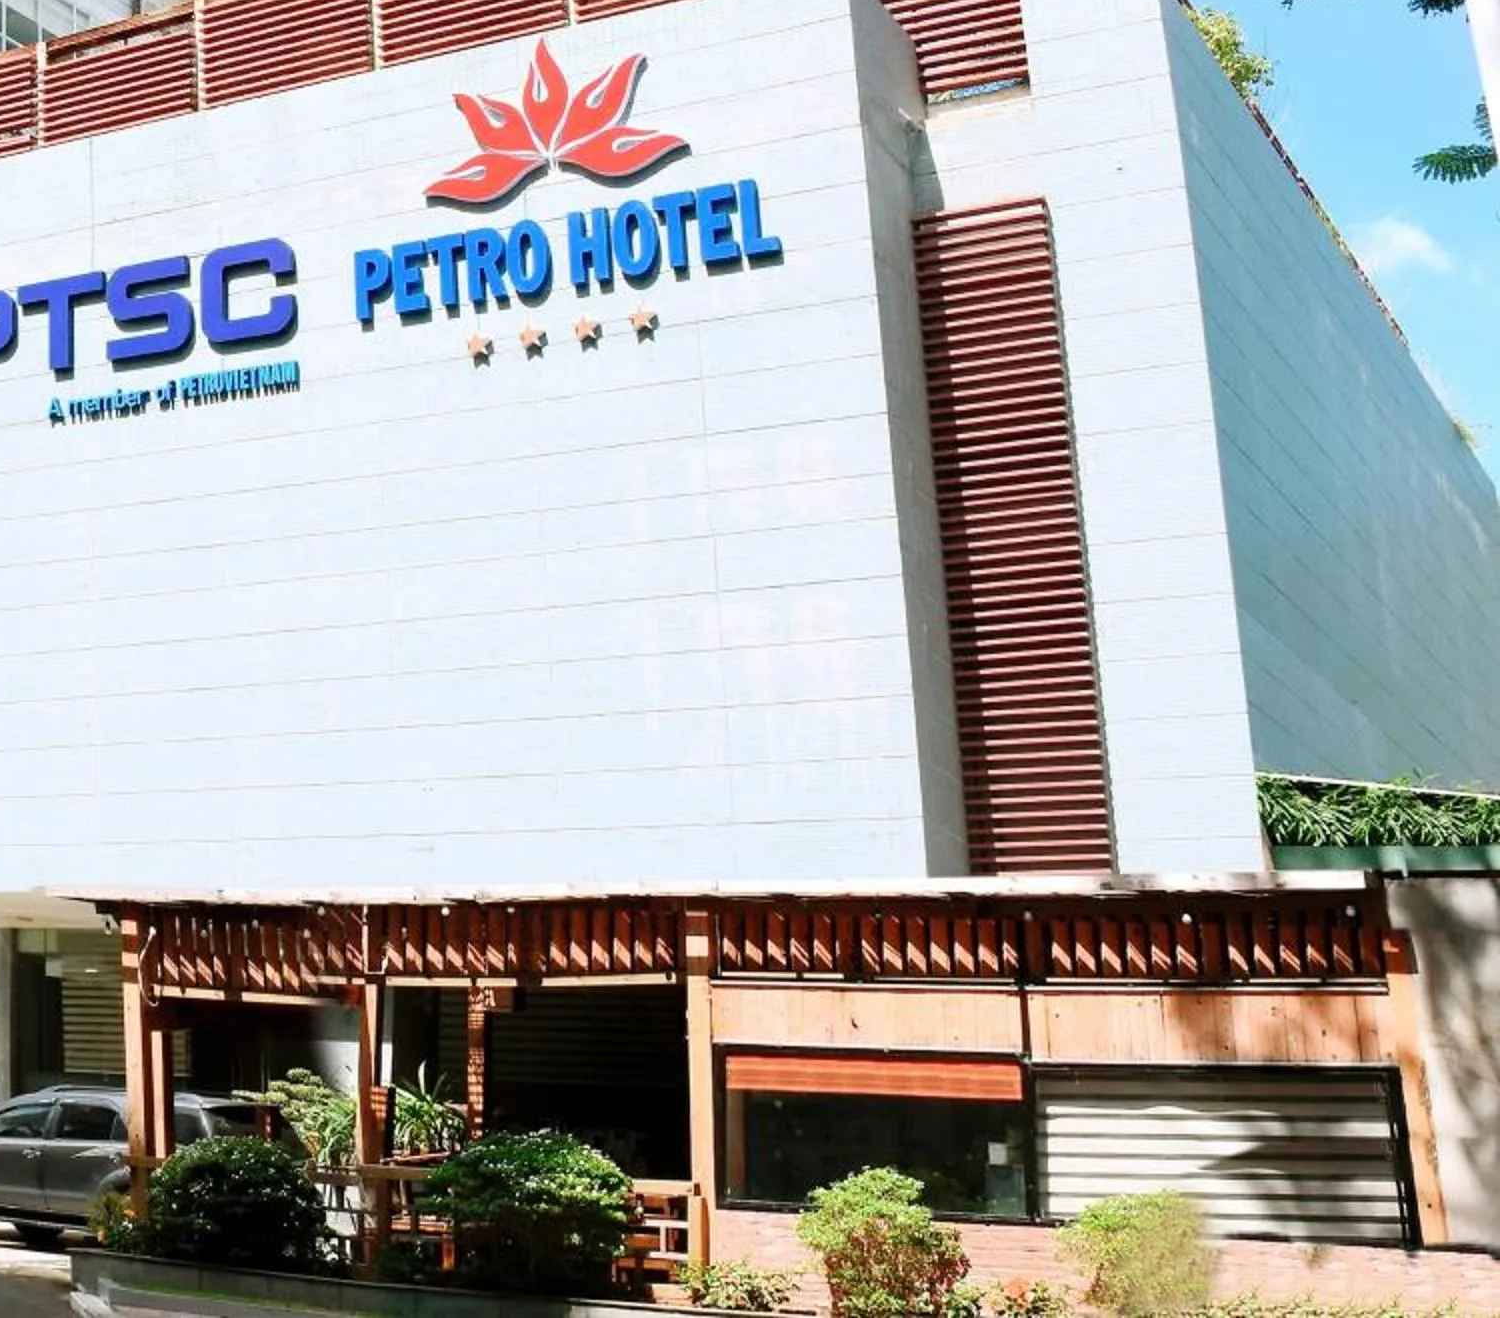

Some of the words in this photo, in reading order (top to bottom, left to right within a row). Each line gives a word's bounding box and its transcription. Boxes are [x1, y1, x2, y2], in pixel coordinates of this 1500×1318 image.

[354, 219, 552, 323] PETRO
[568, 179, 782, 290] HOTEL
[47, 395, 66, 420] A
[68, 387, 151, 414] member
[156, 380, 177, 401] of
